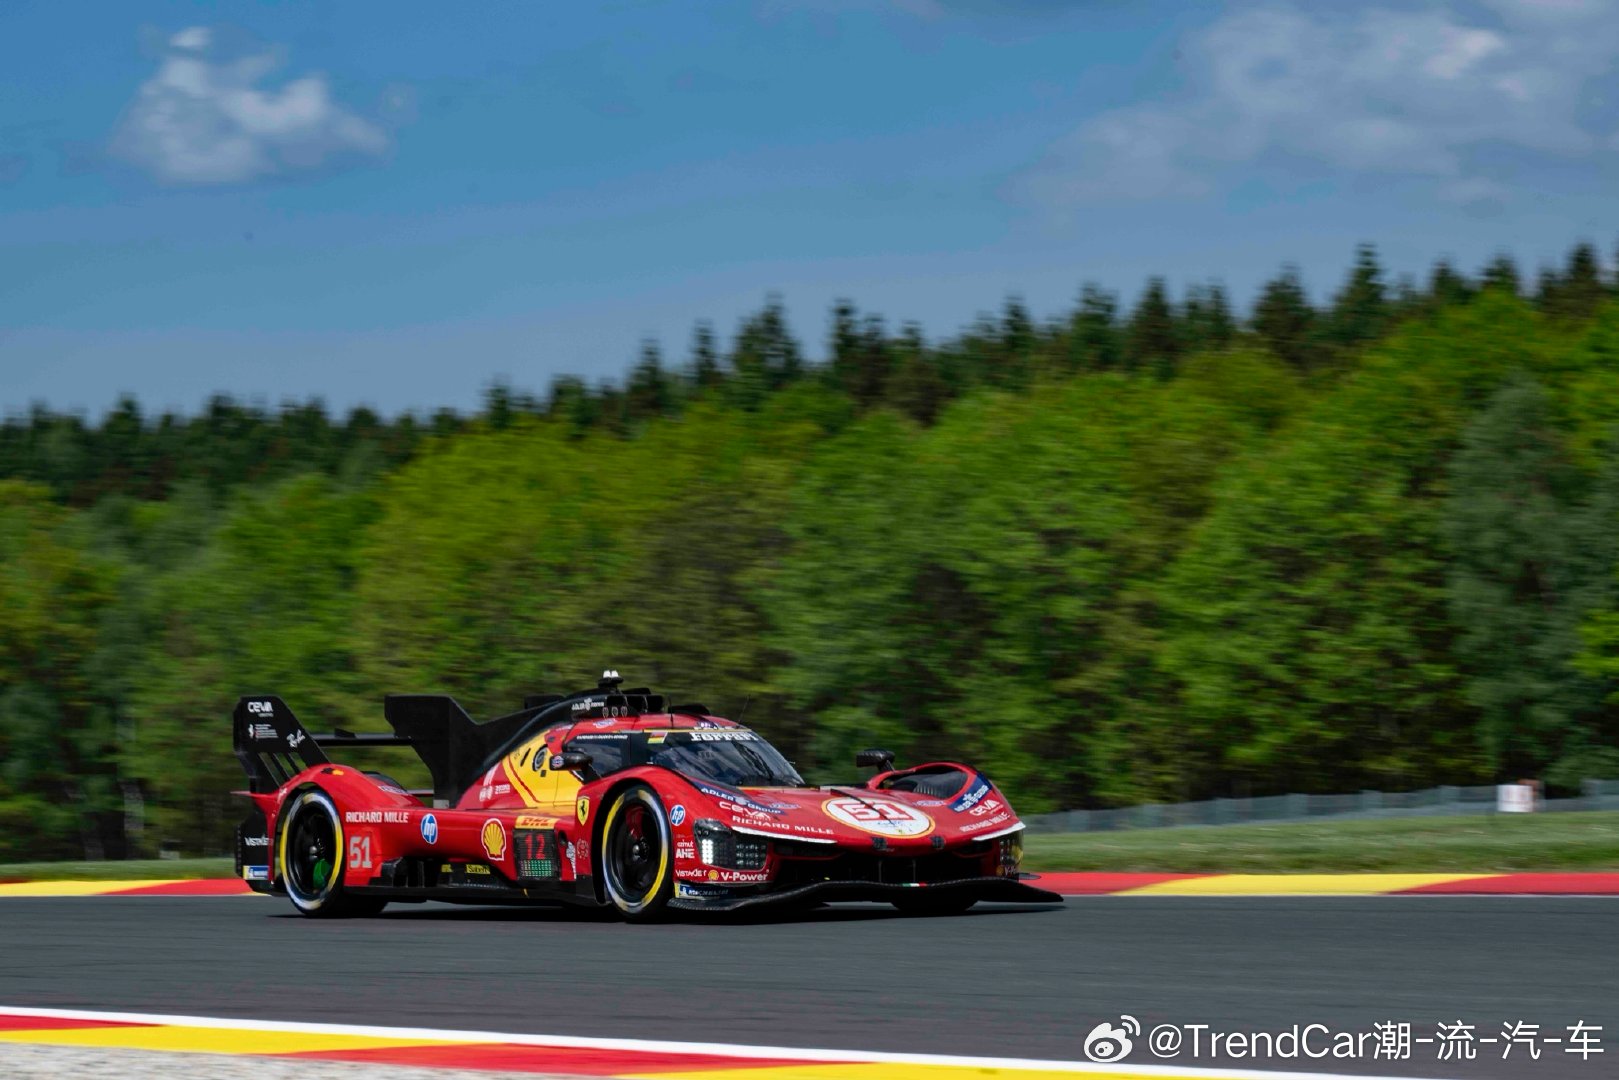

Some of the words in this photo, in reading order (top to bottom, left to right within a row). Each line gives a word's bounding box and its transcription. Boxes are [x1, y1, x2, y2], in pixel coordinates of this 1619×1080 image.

[689, 731, 759, 742] Ferrari
[700, 787, 734, 802] ADLER
[747, 803, 781, 814] GROUP
[345, 811, 382, 823] RICHARD
[384, 812, 409, 823] MILLE
[732, 815, 790, 830] RICHARD
[794, 825, 834, 835] MILLE
[349, 836, 373, 869] 51
[525, 833, 546, 860] 12
[720, 869, 769, 881] V-Power
